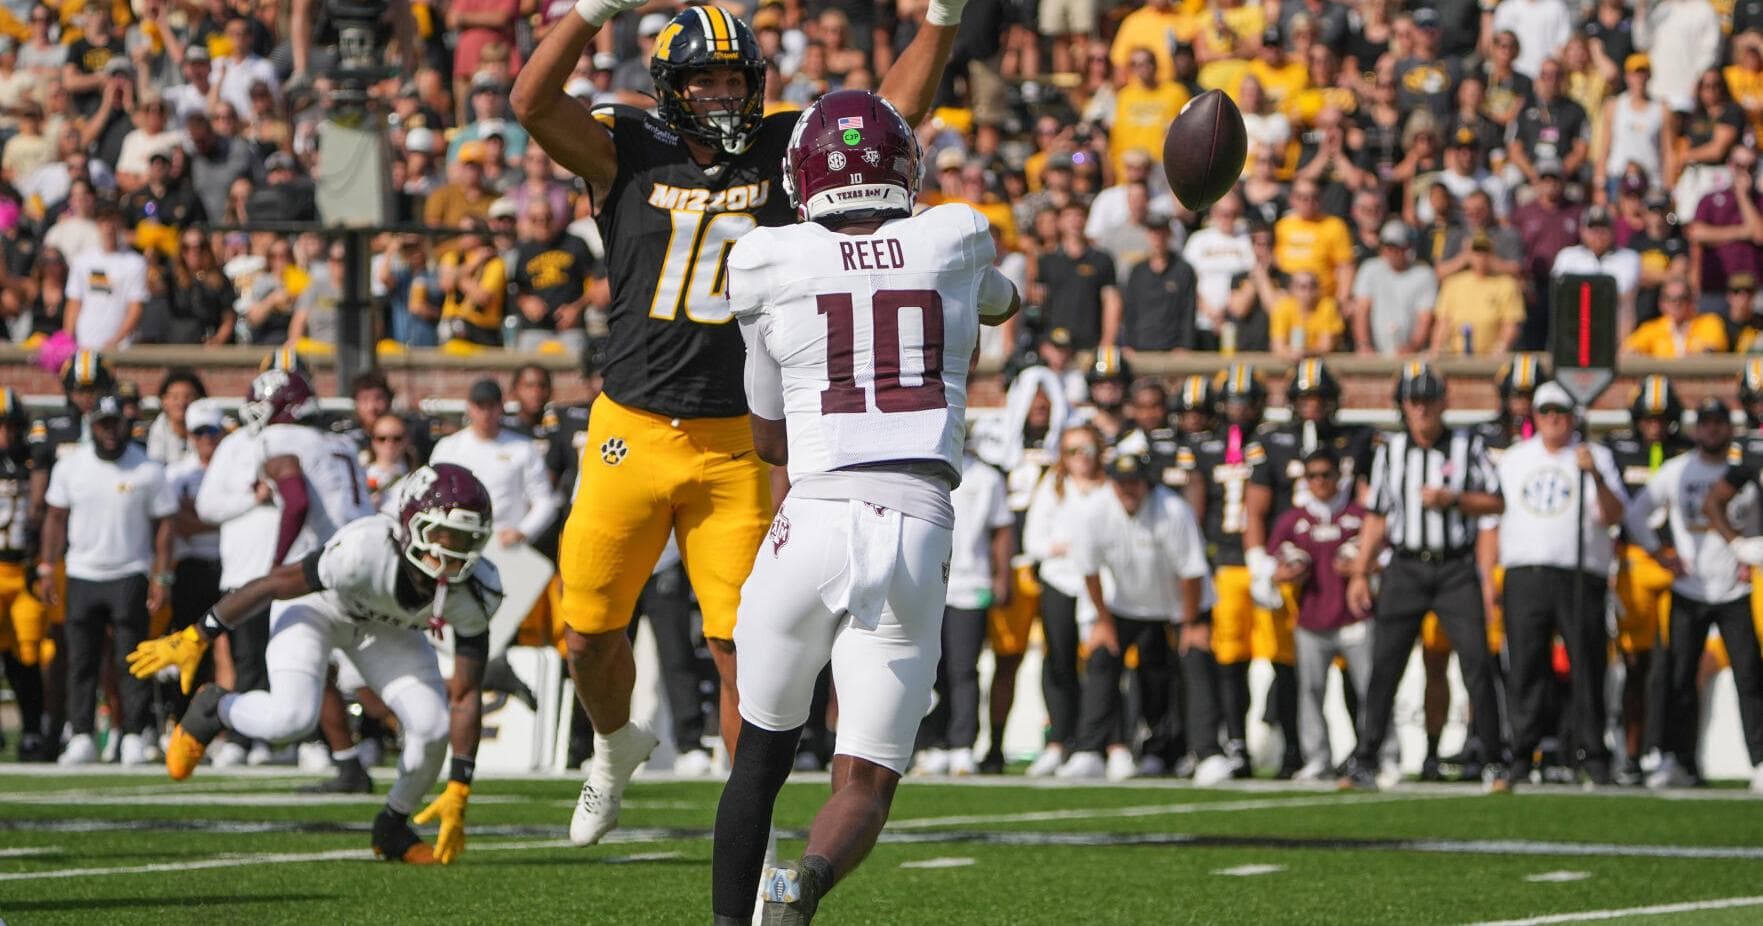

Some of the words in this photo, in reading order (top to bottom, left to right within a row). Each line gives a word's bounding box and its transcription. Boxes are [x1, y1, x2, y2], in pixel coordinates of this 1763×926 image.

[829, 152, 845, 169] SEC
[648, 179, 771, 212] MIZZOU
[836, 189, 863, 201] TEXAS
[849, 173, 863, 185] 10
[648, 209, 758, 325] 10
[839, 238, 905, 271] REED
[815, 289, 949, 417] 10
